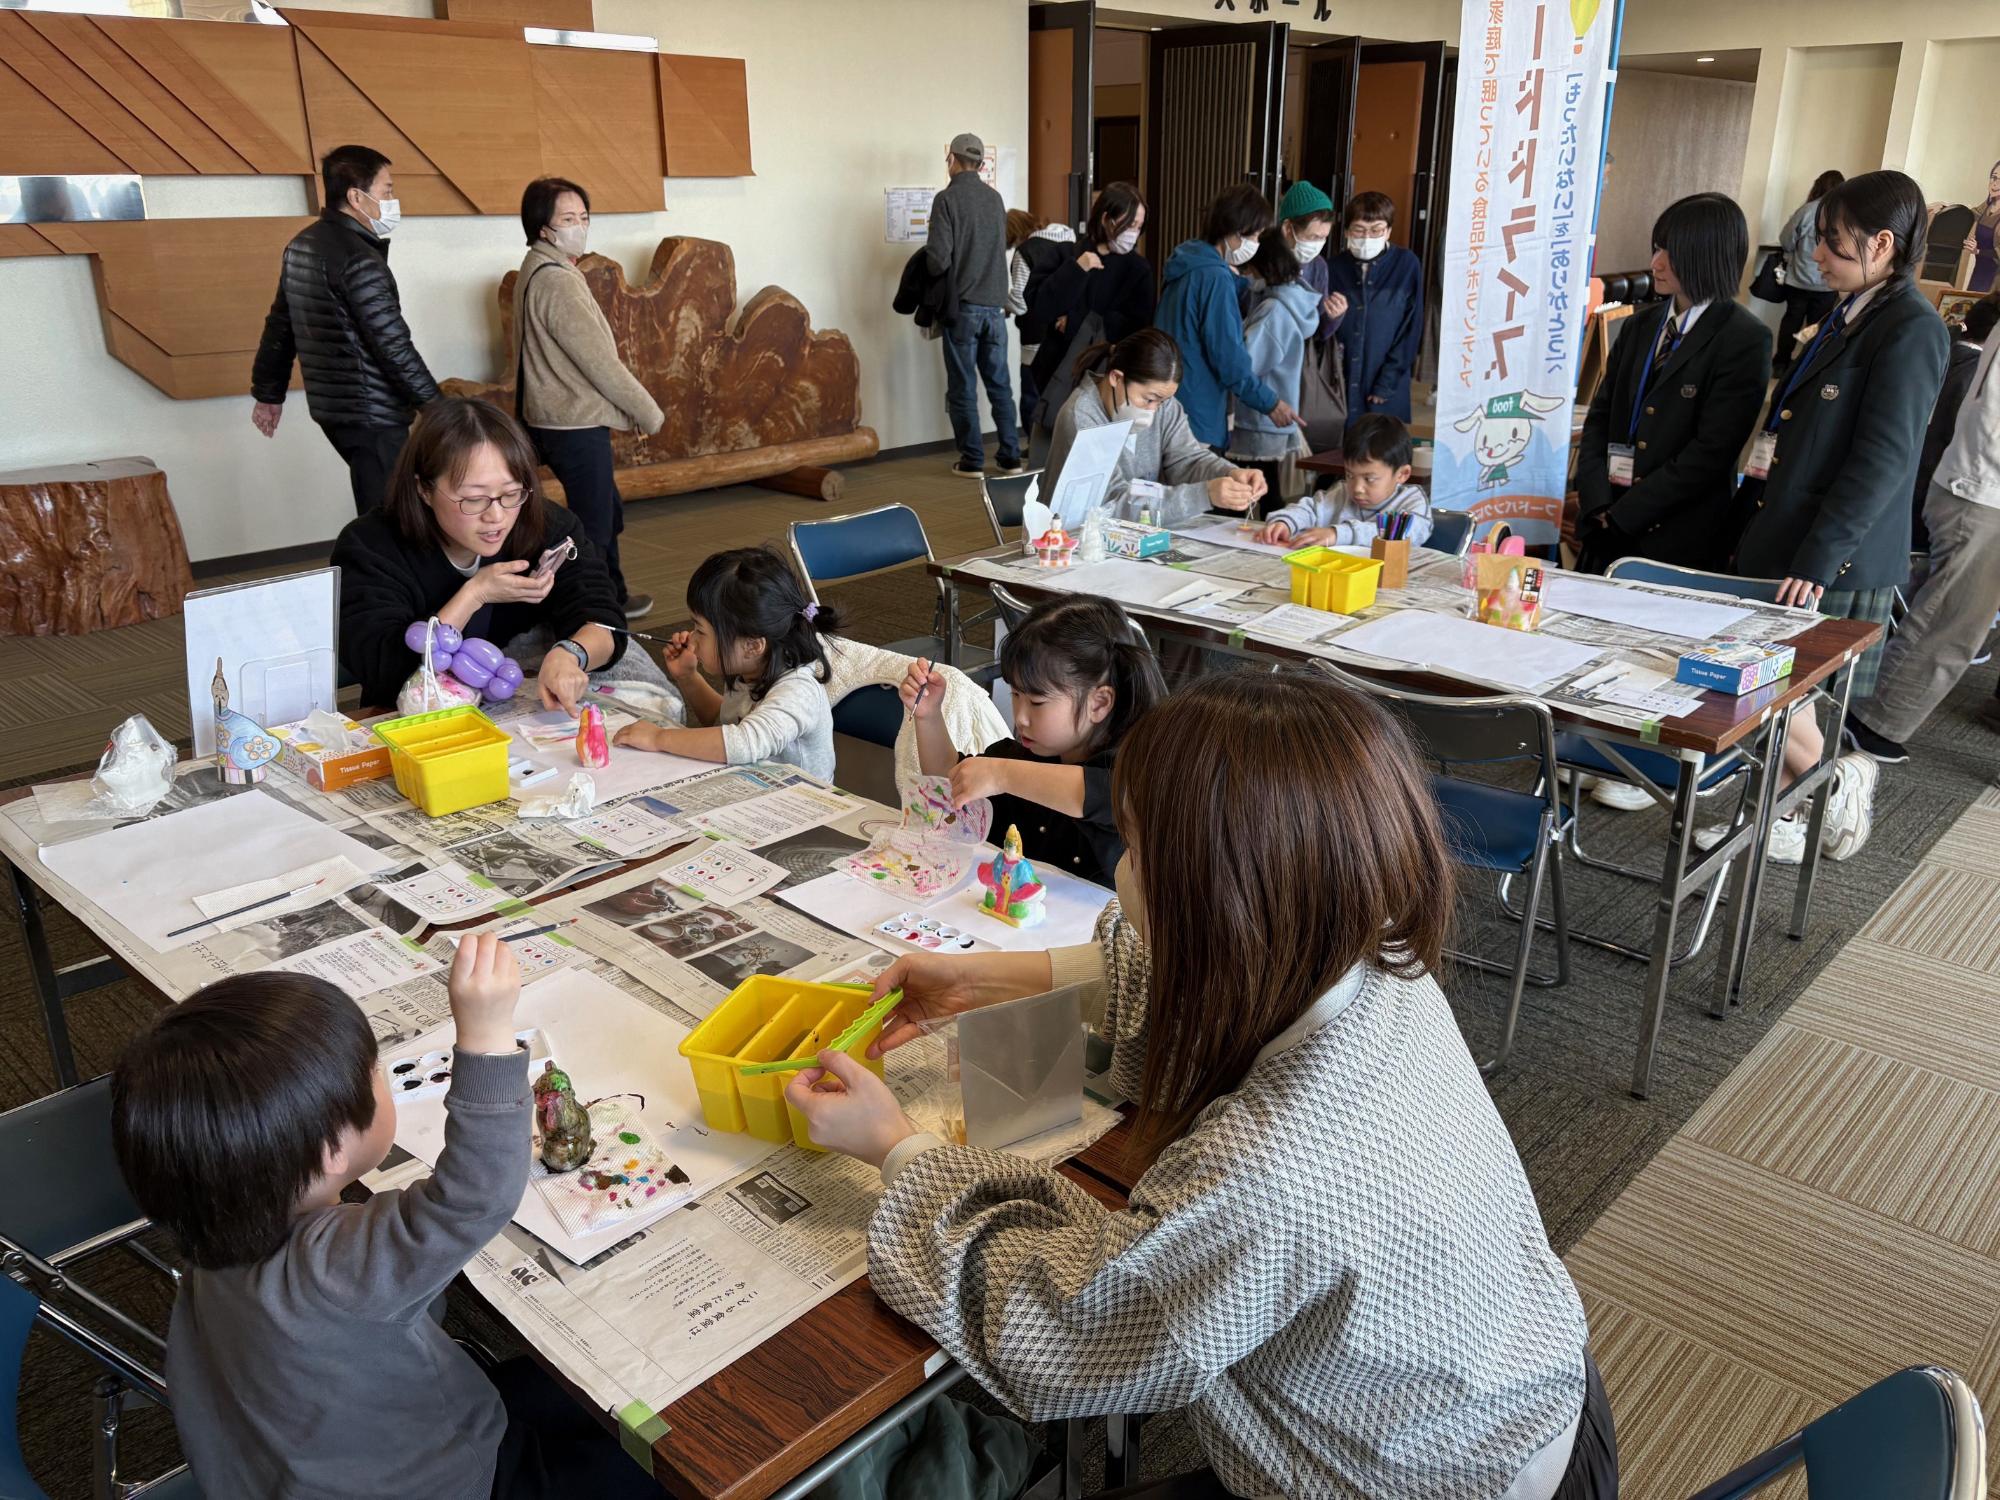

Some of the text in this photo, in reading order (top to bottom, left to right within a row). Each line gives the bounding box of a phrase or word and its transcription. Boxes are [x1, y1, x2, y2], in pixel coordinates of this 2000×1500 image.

[1691, 667, 1727, 681] Tissue Paper
[340, 759, 381, 774] Tissue Paper
